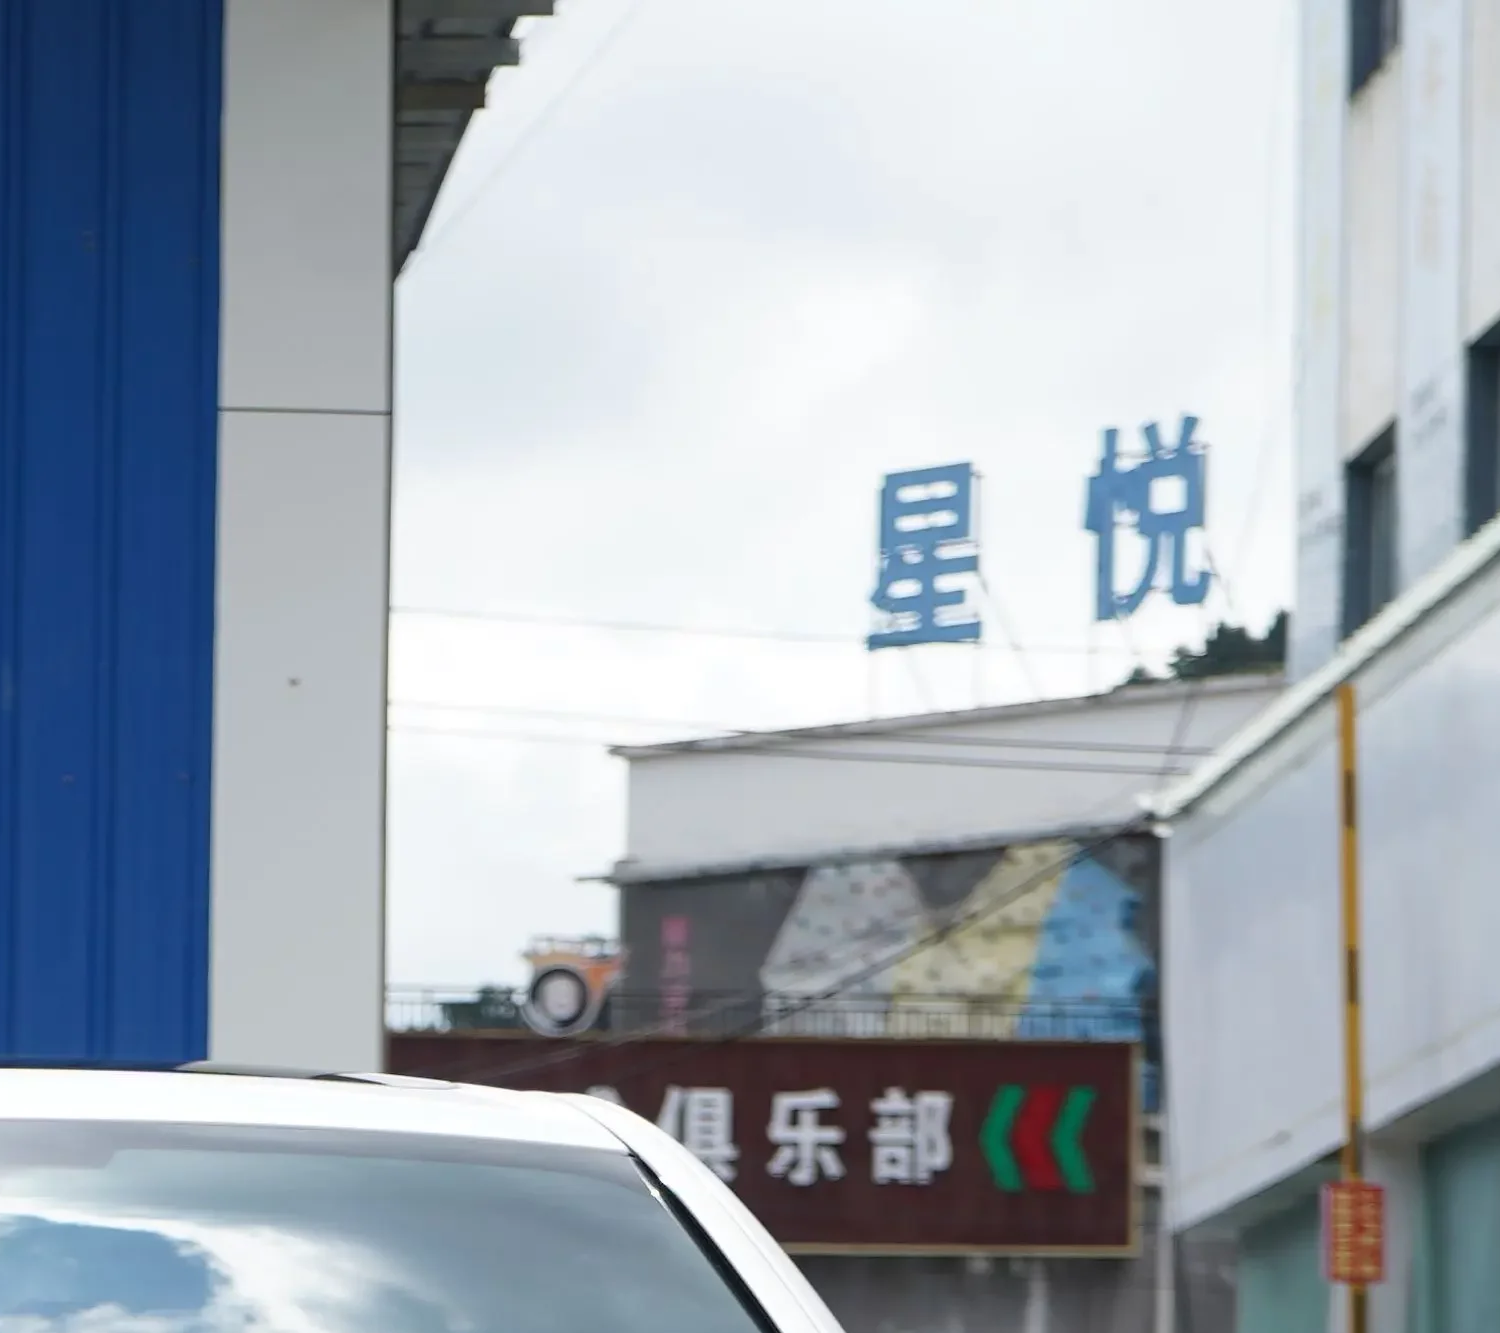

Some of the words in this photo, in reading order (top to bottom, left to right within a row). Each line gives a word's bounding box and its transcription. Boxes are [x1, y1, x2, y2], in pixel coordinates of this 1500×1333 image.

[865, 415, 1209, 652] 星悦
[586, 1085, 954, 1186] 俱乐部
